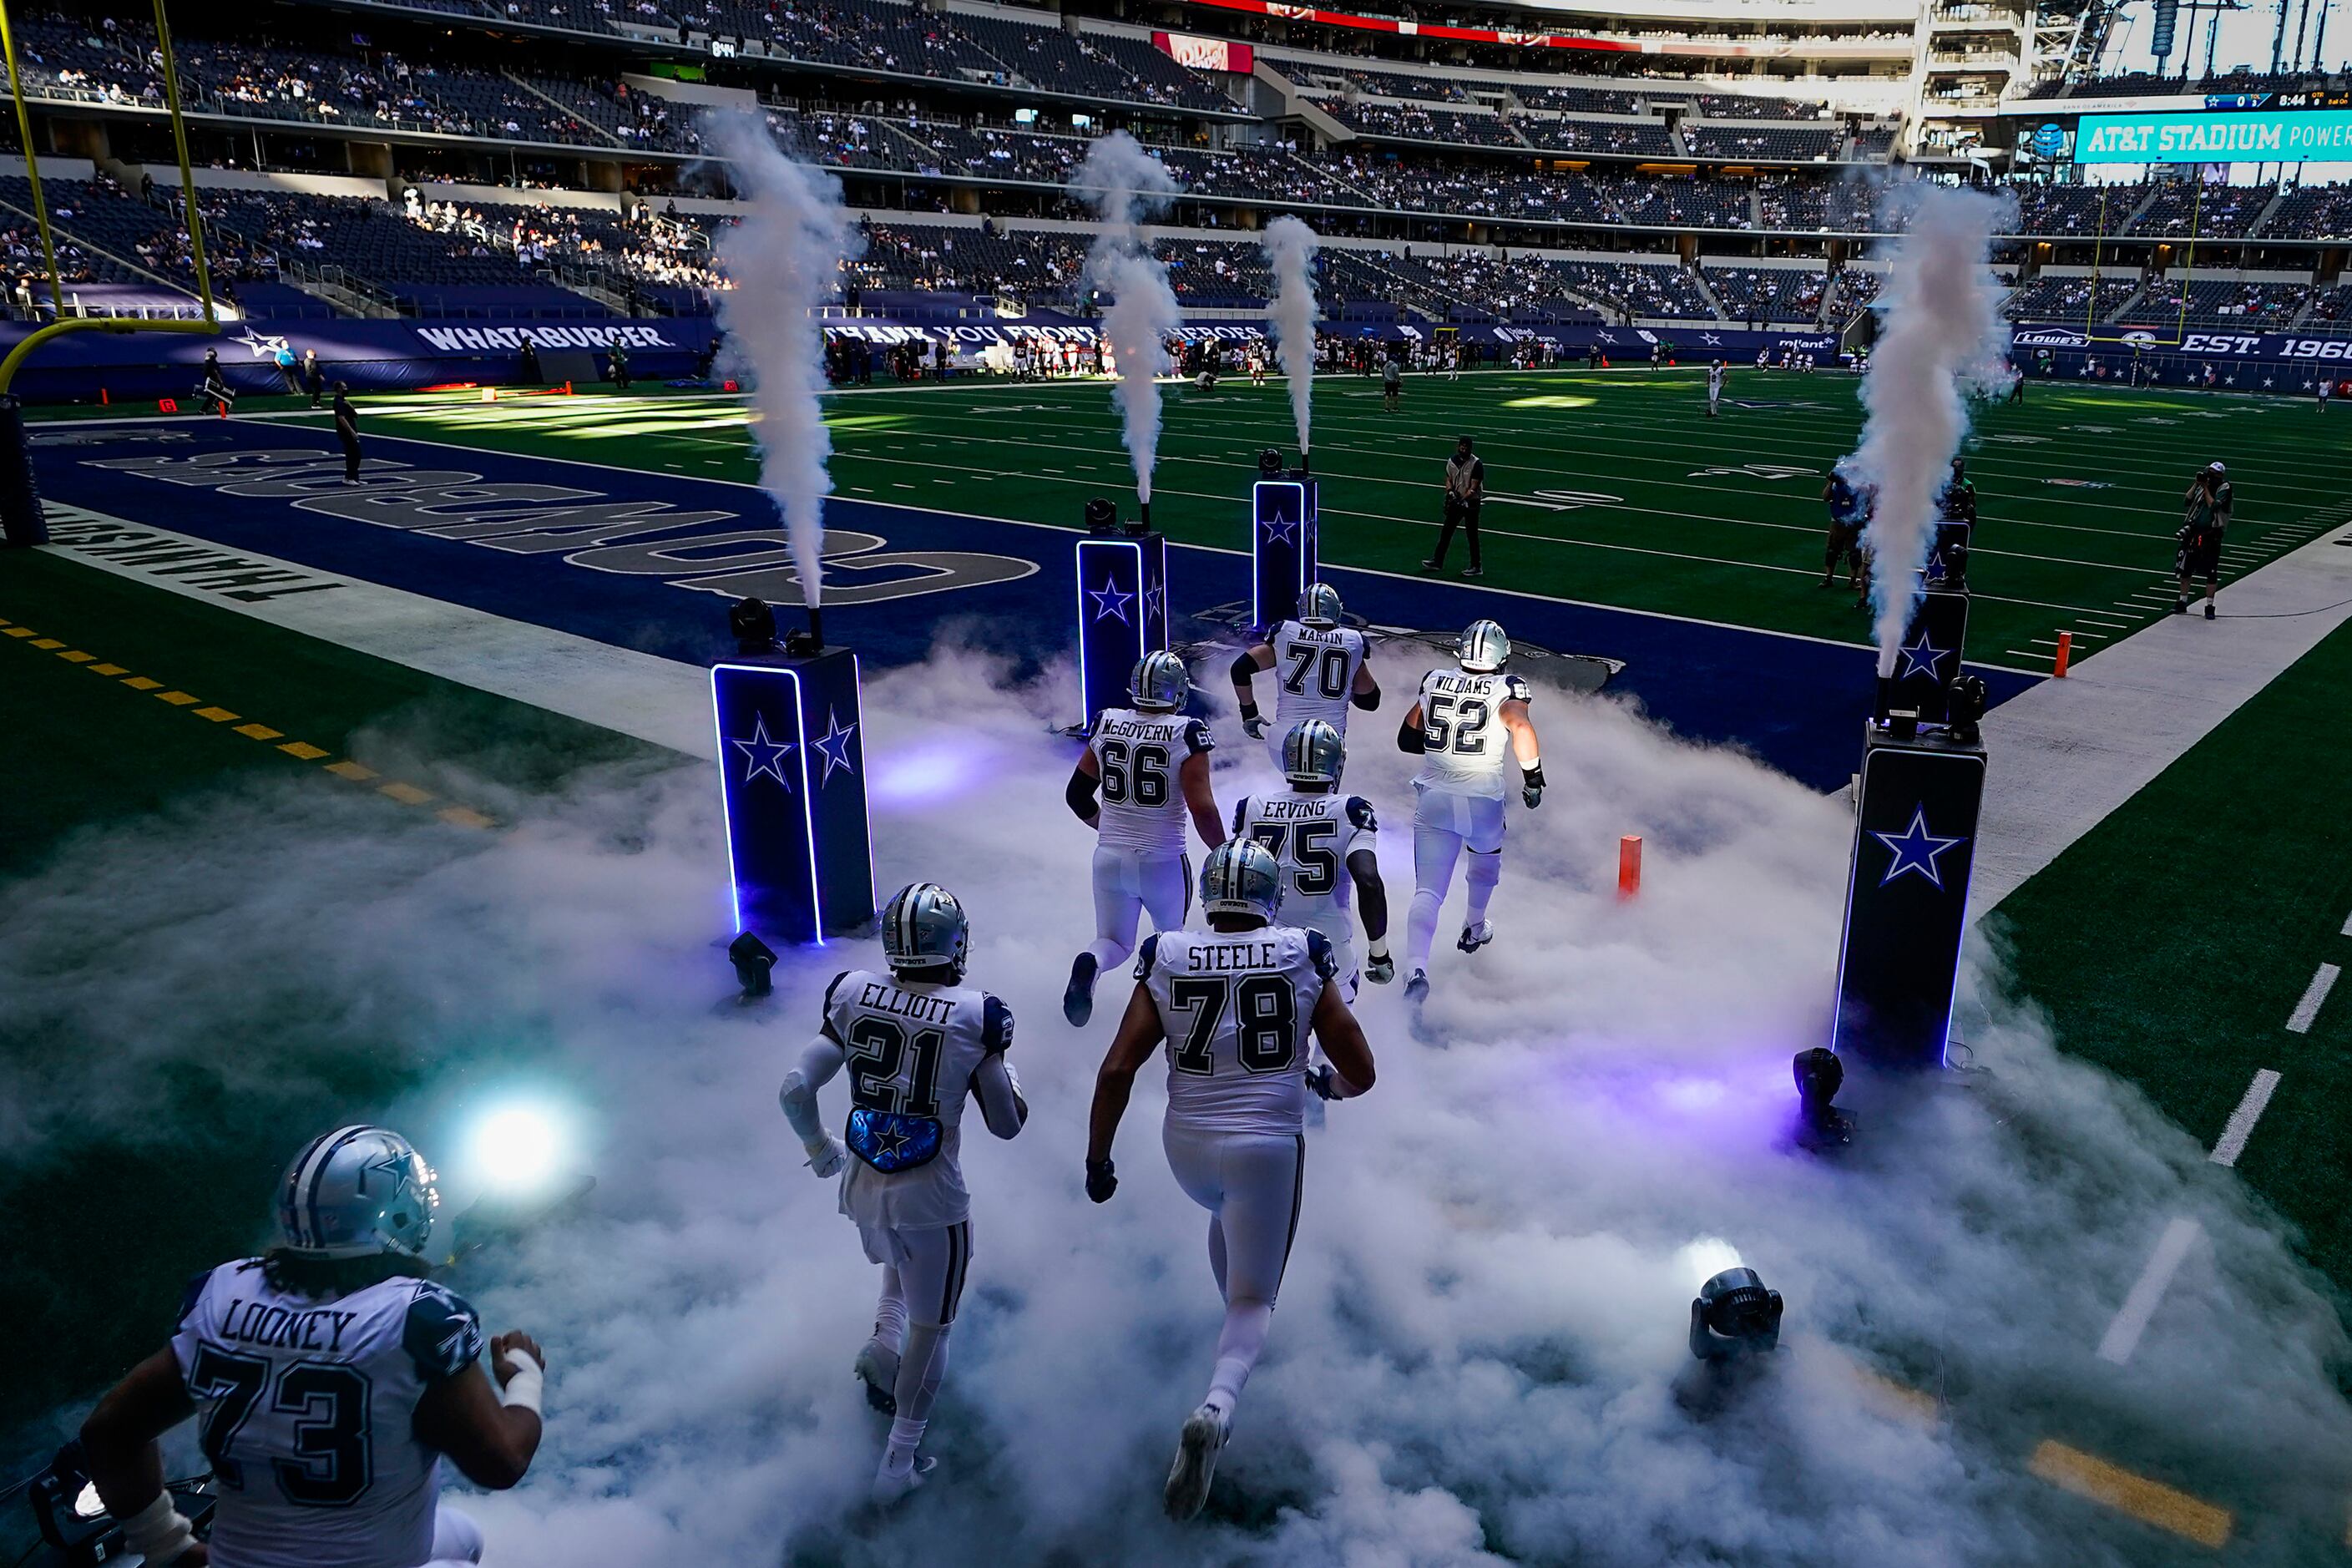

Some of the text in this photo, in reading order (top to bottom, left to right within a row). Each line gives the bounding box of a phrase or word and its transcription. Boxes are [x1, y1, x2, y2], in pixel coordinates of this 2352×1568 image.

[2279, 94, 2306, 107] 8:44
[2087, 124, 2154, 153] AT&T
[2158, 123, 2284, 151] STADIUM
[417, 326, 671, 351] WHATABURGER
[823, 326, 1096, 344] THANK YOU FRONT
[1166, 326, 1264, 341] HEROES
[2022, 334, 2083, 345] LOWE'S
[2180, 334, 2260, 355] EST.
[1297, 628, 1343, 645] MARTIN
[1283, 640, 1352, 701] 70
[1434, 675, 1492, 695] WILLIAMS
[1100, 718, 1175, 742] McGOVERN
[1424, 692, 1490, 756] 52
[1100, 738, 1171, 808] 66
[1262, 799, 1326, 819] ERVING
[1252, 819, 1338, 897] 75
[1188, 943, 1277, 972] STEELE
[858, 982, 957, 1025] ELLIOTT
[1169, 973, 1297, 1077] 78
[847, 1013, 945, 1116] 21
[220, 1298, 357, 1353] LOONEY
[186, 1338, 374, 1508] 73
